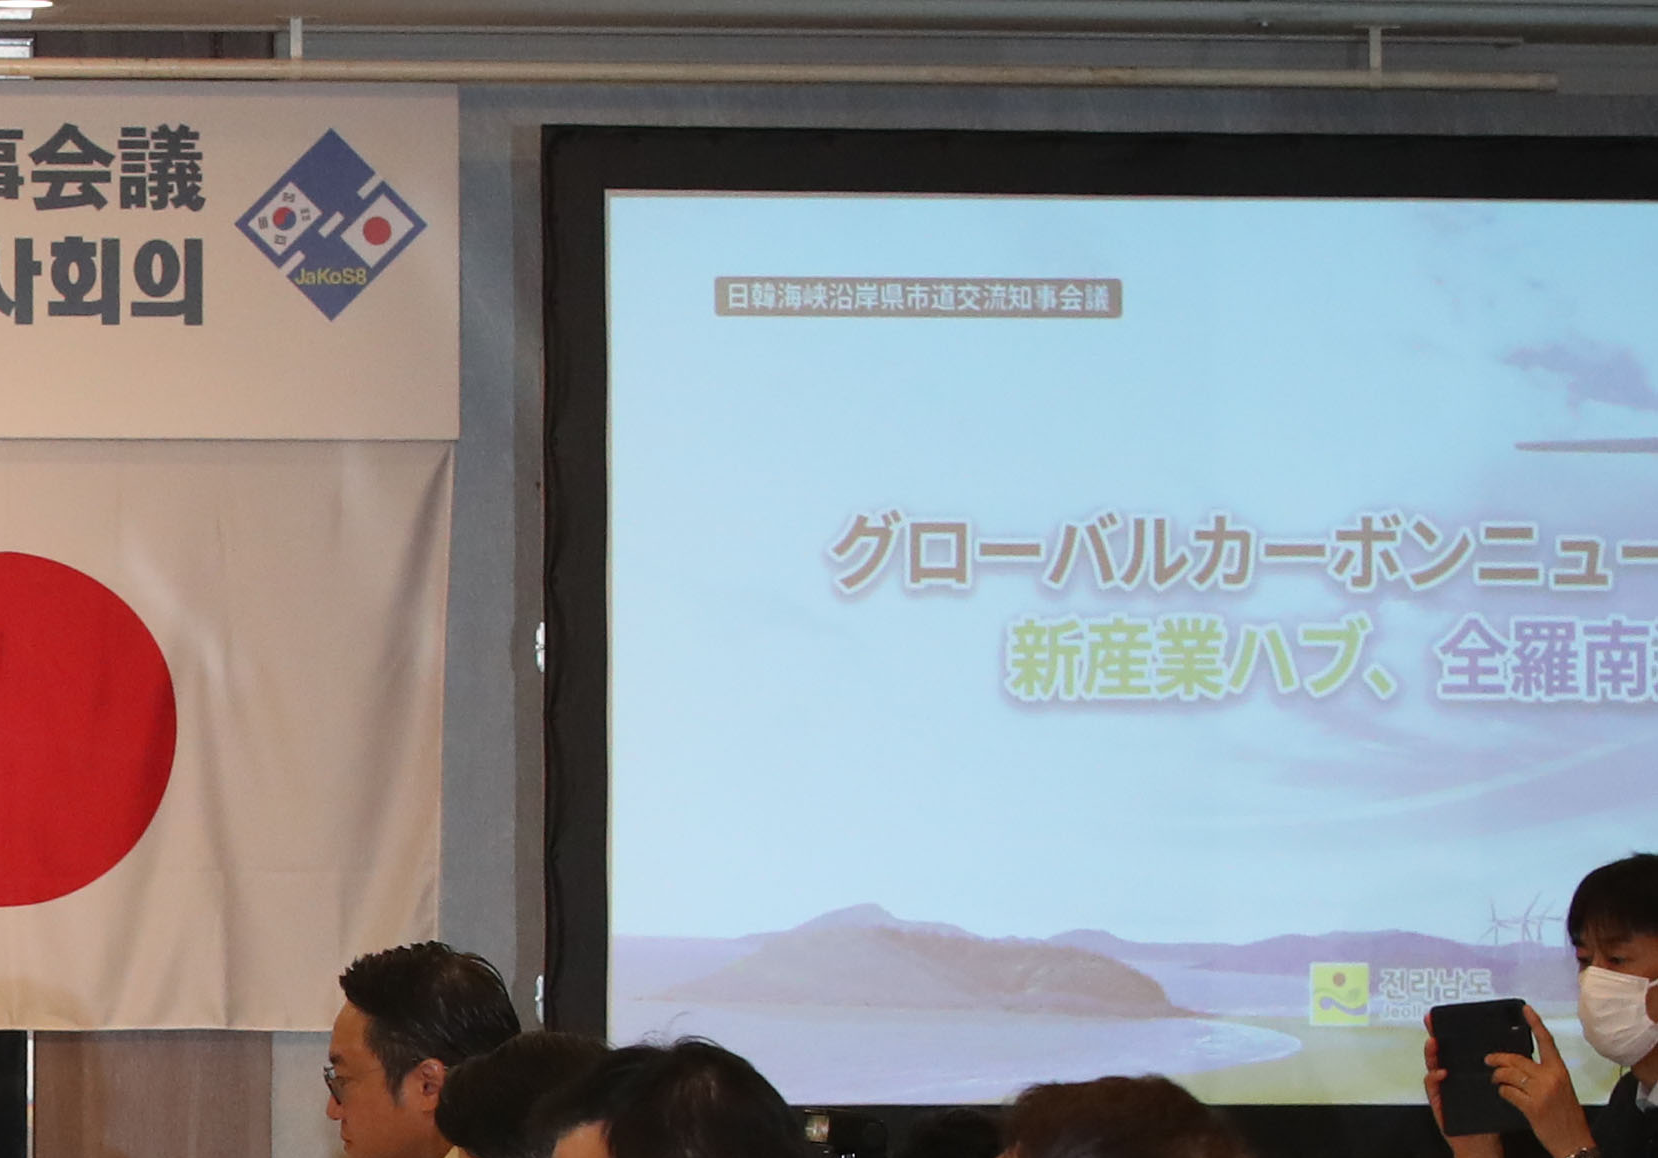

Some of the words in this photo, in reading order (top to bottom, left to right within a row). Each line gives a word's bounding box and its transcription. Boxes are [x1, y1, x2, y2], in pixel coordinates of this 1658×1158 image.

[295, 267, 368, 286] JaKoS8
[727, 282, 1110, 313] 日韓海峡沿岸県市道交流知事会議
[831, 508, 1658, 590] グローバルカーボンニュー
[1008, 616, 1658, 699] 新産業ハブ、全羅南
[1380, 968, 1492, 1000] 전라남도
